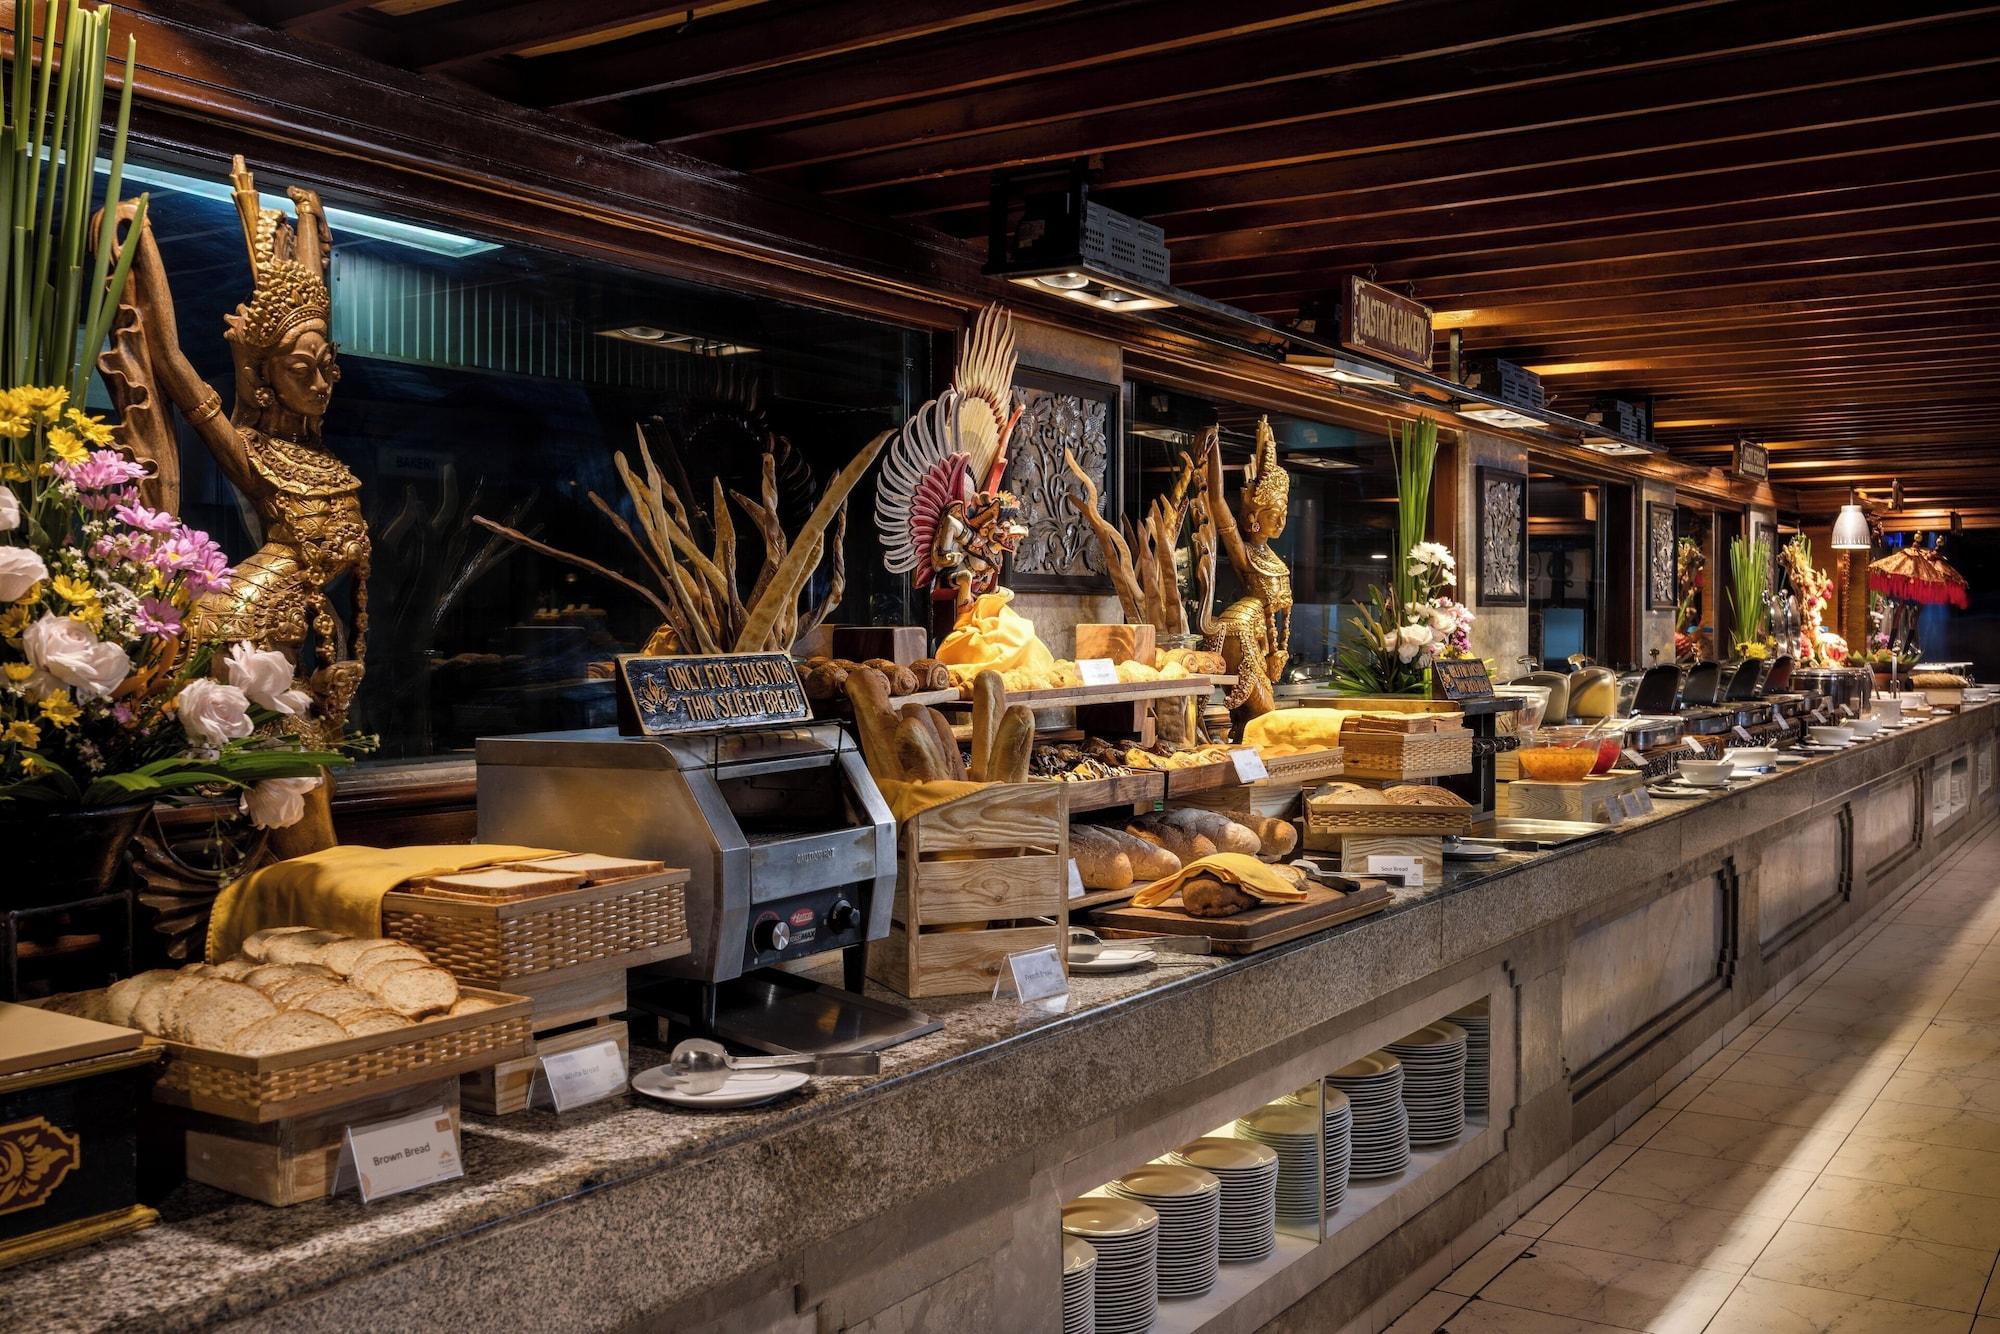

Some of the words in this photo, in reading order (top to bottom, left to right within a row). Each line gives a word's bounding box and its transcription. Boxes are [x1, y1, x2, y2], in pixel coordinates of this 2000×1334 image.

[1360, 294, 1390, 342] PASTRY
[1391, 307, 1397, 345] &
[1398, 309, 1427, 355] BAKERY
[667, 666, 703, 690] ONLY
[704, 664, 732, 688] FOR
[736, 661, 794, 687] TOASTING
[682, 695, 718, 721] THIN
[720, 691, 763, 718] SLICED
[763, 688, 801, 713] BREAD
[373, 1151, 403, 1166] Brown
[404, 1142, 431, 1158] Bread
